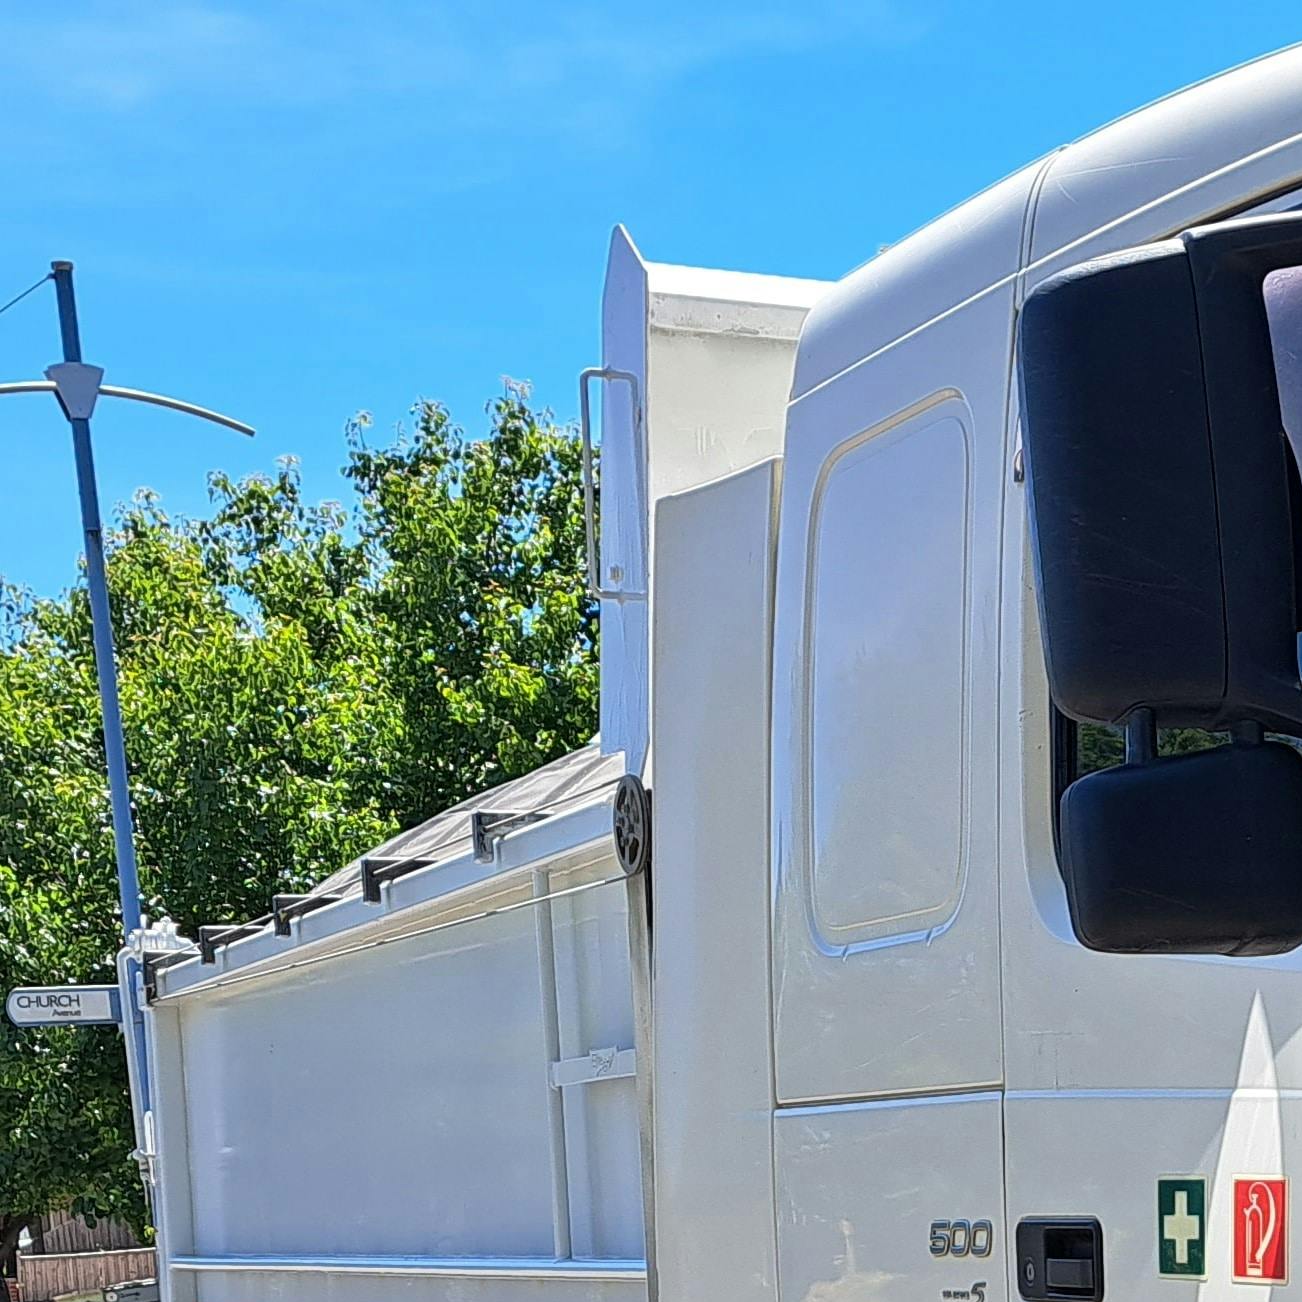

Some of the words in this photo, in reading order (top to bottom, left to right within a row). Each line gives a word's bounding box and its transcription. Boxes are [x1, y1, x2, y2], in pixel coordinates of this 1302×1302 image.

[16, 994, 81, 1009] CHURCH
[51, 1008, 82, 1017] Avenue
[928, 1218, 993, 1257] 500
